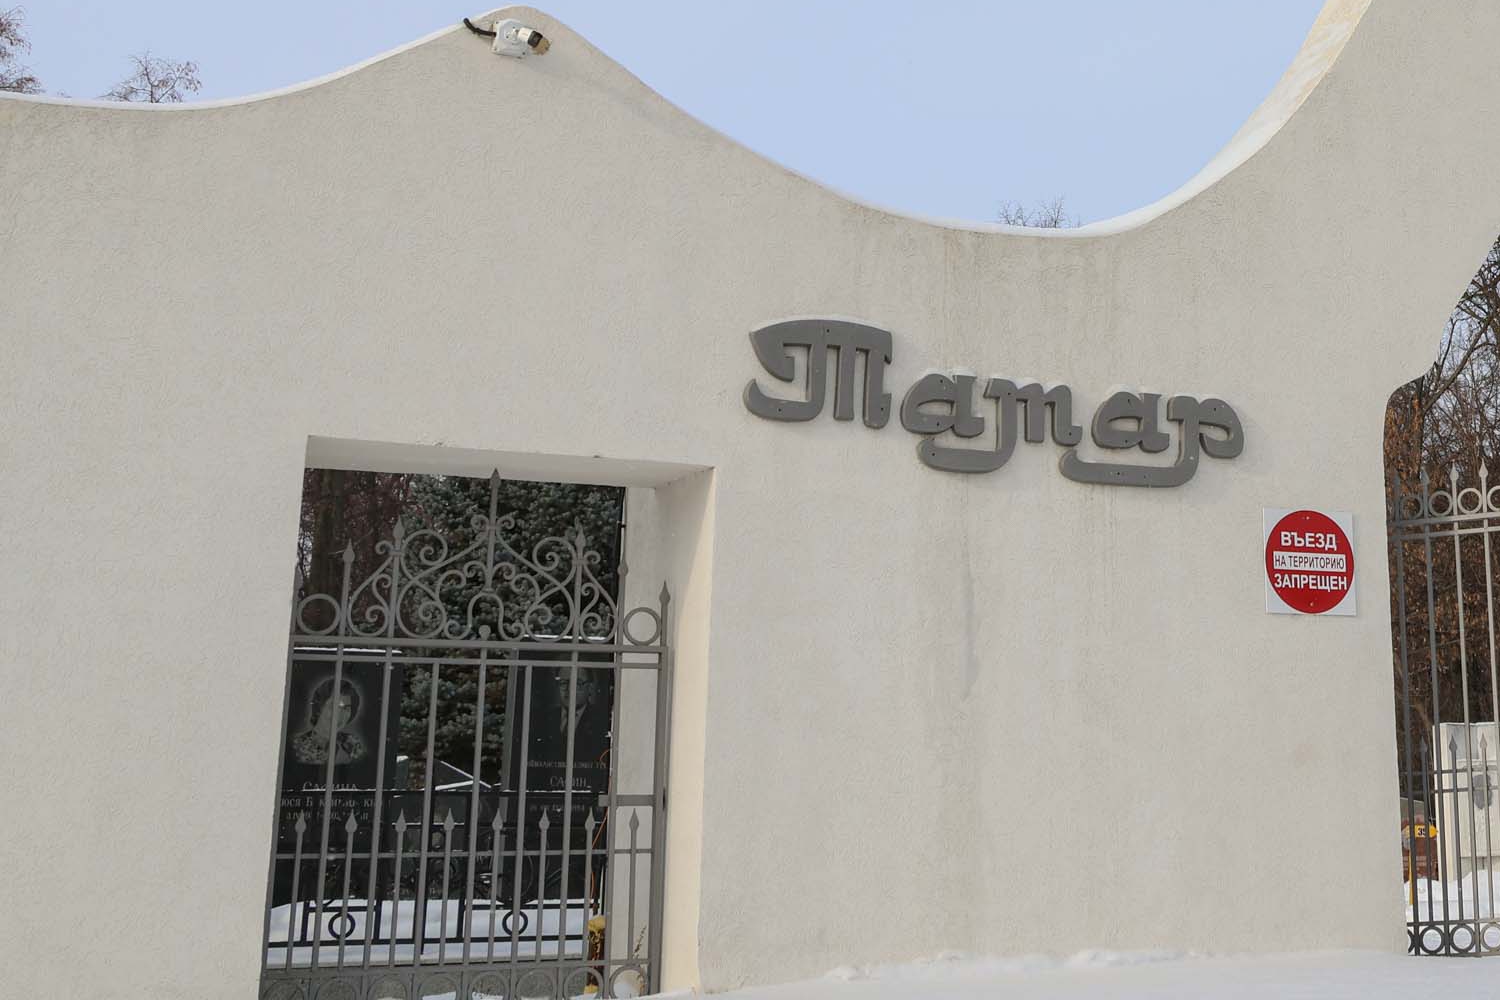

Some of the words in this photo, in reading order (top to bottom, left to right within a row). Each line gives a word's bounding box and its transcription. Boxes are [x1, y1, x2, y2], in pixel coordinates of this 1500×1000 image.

[1280, 531, 1337, 551] ВЪЕЗД
[1274, 554, 1287, 568] НА
[1288, 555, 1345, 570] ТЕРРИТОРИЮ
[1274, 573, 1348, 593] ЗАПРЕЩЕН
